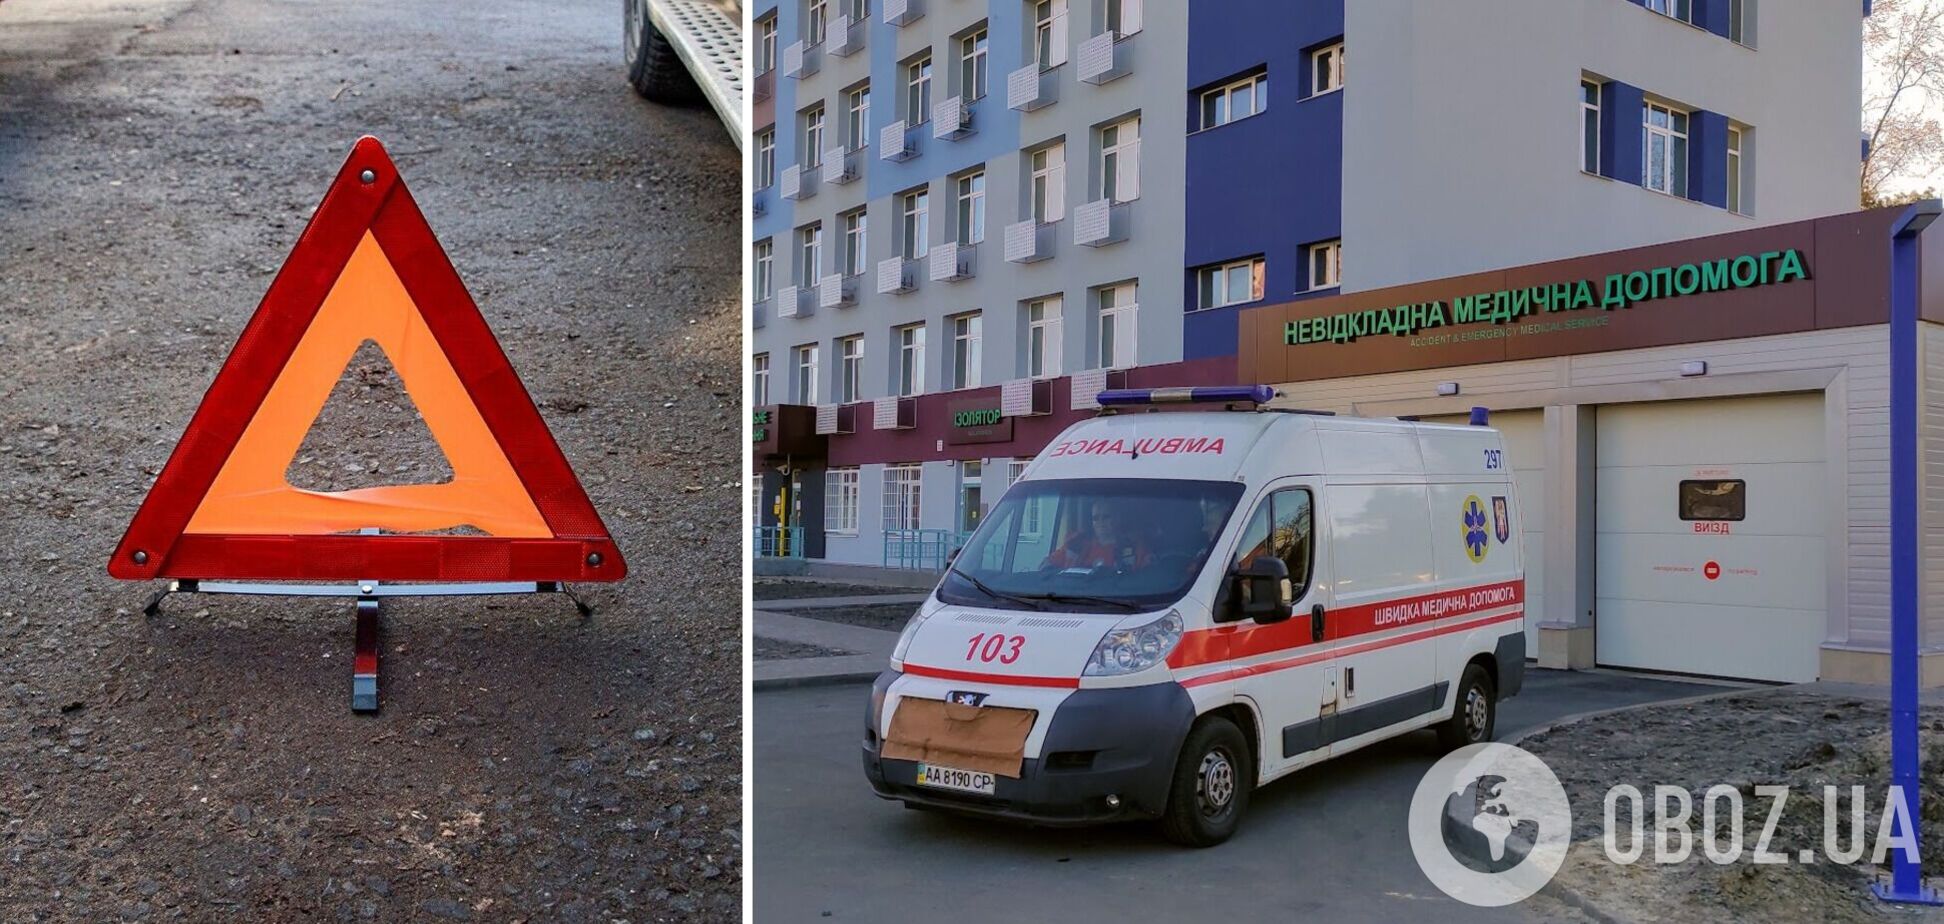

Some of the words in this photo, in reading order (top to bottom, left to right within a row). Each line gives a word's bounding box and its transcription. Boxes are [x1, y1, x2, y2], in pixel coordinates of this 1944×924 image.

[1283, 301, 1444, 345] НЕВІДКЛАДНА
[1453, 280, 1593, 324] МЕДИЧНА
[1602, 249, 1804, 306] ДОПОМОГА
[1410, 334, 1451, 347] ACCIDENT
[1461, 327, 1518, 342] EMERGENCY
[1520, 321, 1562, 335] MEDICAL
[1564, 315, 1609, 329] SERVICE
[954, 409, 1001, 427] ІЗОЛЯТОР
[1484, 449, 1502, 469] 297
[1375, 604, 1420, 625] ШВИДКА
[1422, 595, 1467, 617] МЕДИЧНА
[1469, 586, 1515, 610] ДОПОМОГА
[966, 633, 1025, 664] 103
[926, 767, 941, 783] AA
[944, 770, 970, 787] 8190
